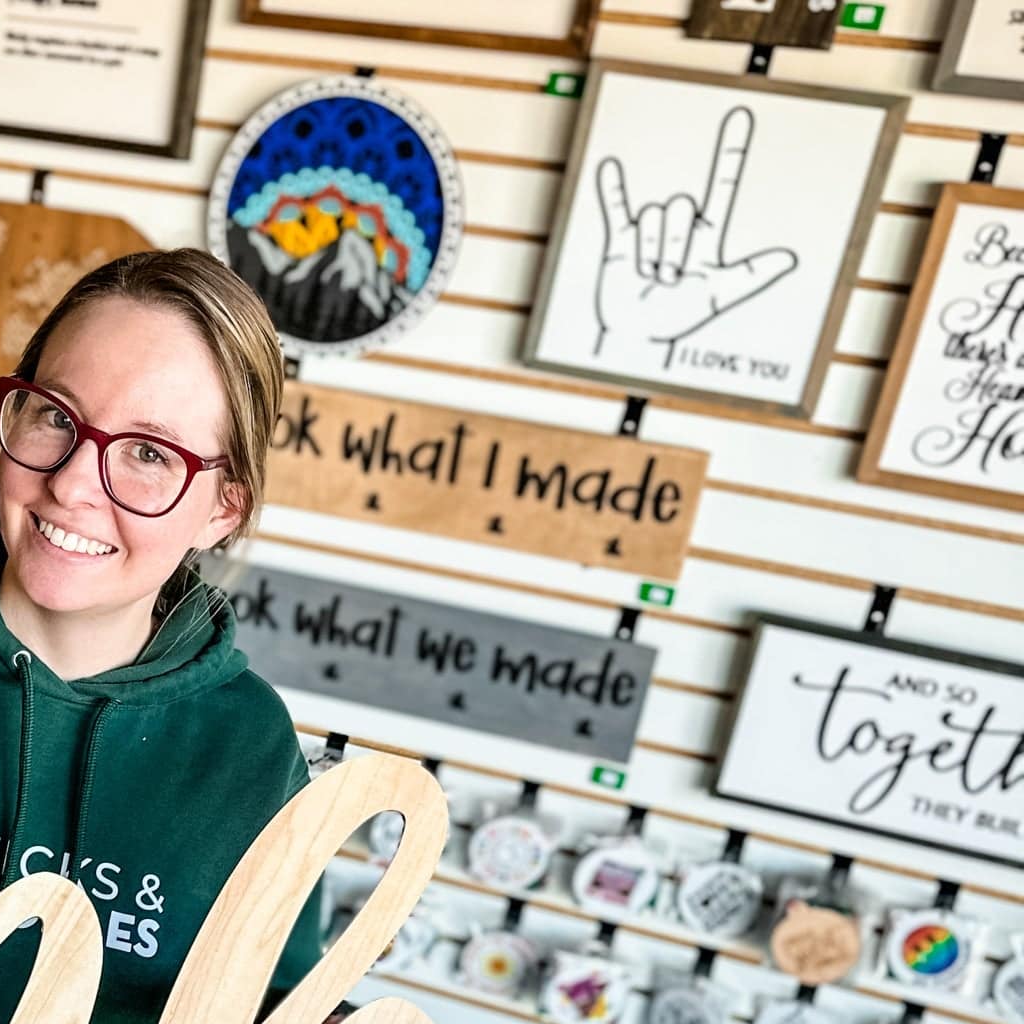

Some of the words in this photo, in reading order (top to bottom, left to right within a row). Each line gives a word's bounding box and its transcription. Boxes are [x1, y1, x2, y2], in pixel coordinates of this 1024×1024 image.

[690, 349, 740, 374] LOVE
[748, 359, 790, 381] YOU
[342, 411, 472, 487] what
[482, 440, 500, 489] I
[514, 454, 683, 525] made
[293, 593, 404, 659] what
[415, 625, 479, 674] we
[490, 642, 638, 708] made
[885, 672, 939, 697] AND
[944, 682, 978, 705] SO
[911, 795, 970, 825] THEY
[135, 873, 165, 914] &
